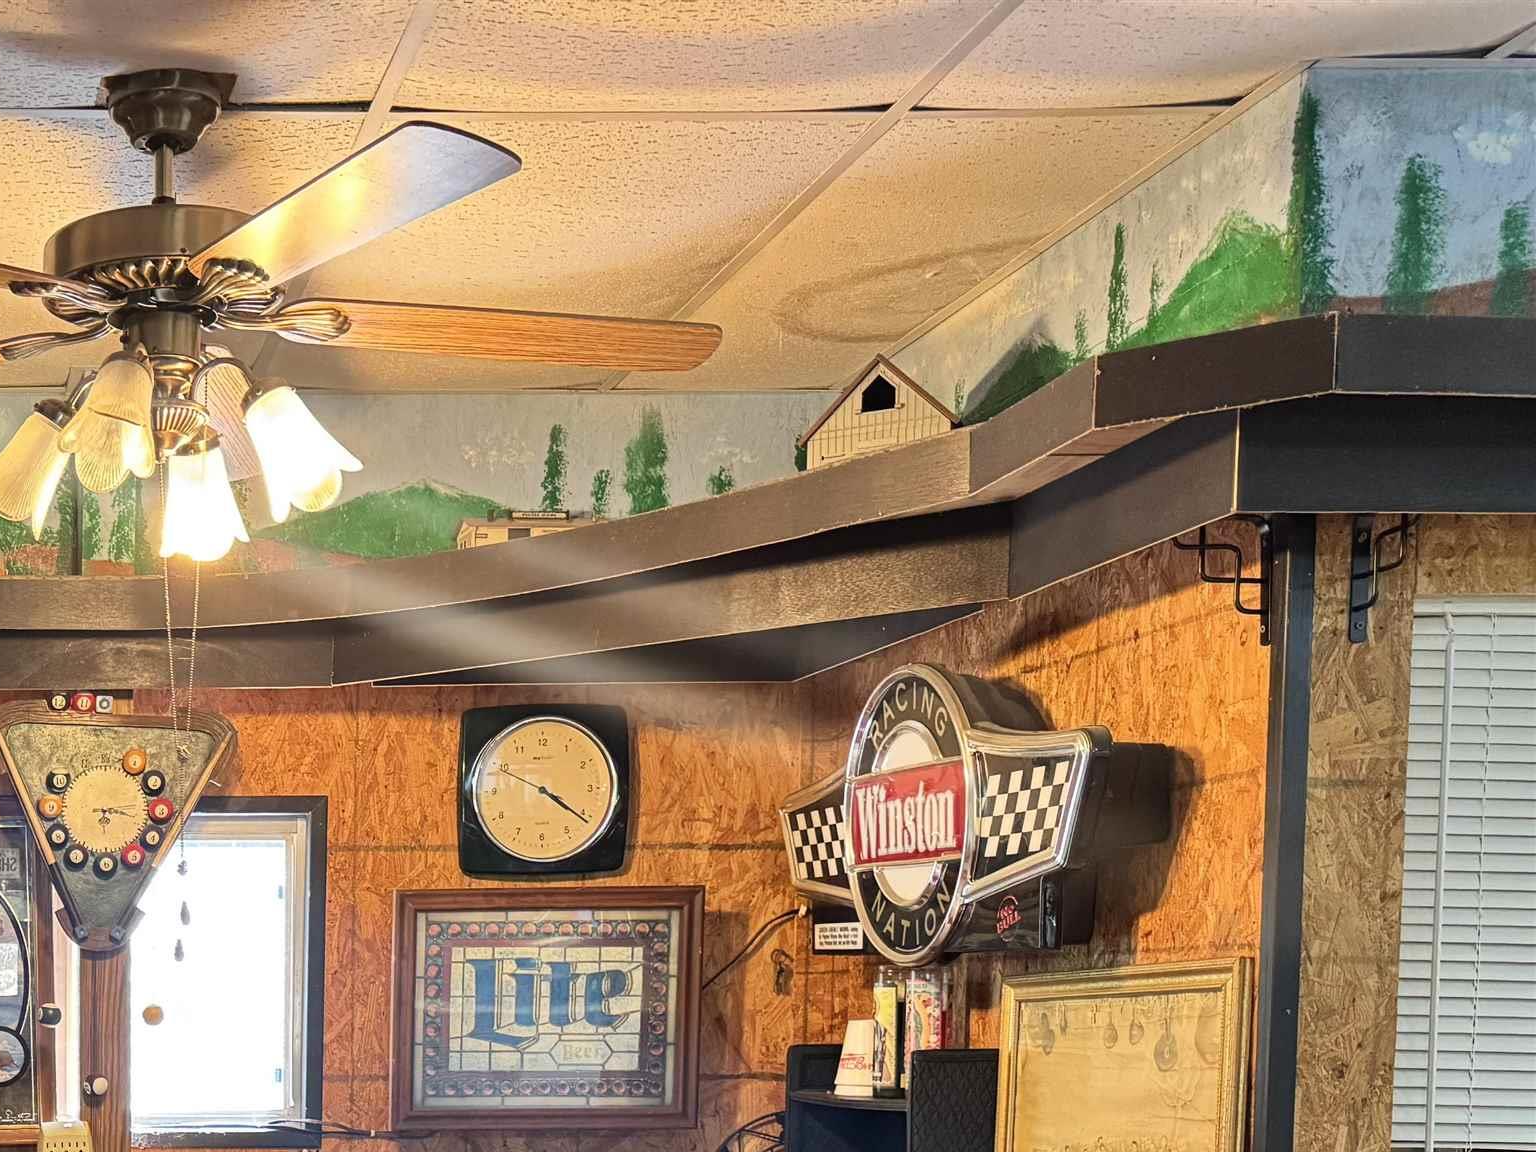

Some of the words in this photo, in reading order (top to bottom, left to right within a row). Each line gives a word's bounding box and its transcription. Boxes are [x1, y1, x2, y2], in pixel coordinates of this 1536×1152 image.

[55, 697, 64, 707] 12
[80, 699, 88, 708] 11
[870, 682, 947, 750] RACING
[538, 738, 548, 747] 12
[515, 746, 524, 754] 11
[565, 744, 568, 752] 1
[500, 763, 510, 771] 10
[580, 761, 586, 769] 2
[587, 784, 593, 792] 3
[498, 811, 504, 819] 8
[855, 780, 957, 859] Winston
[564, 826, 570, 834] 5
[539, 832, 545, 841] 6
[872, 881, 951, 946] NATION
[996, 911, 1022, 934] BULL
[465, 957, 628, 1048] Lite
